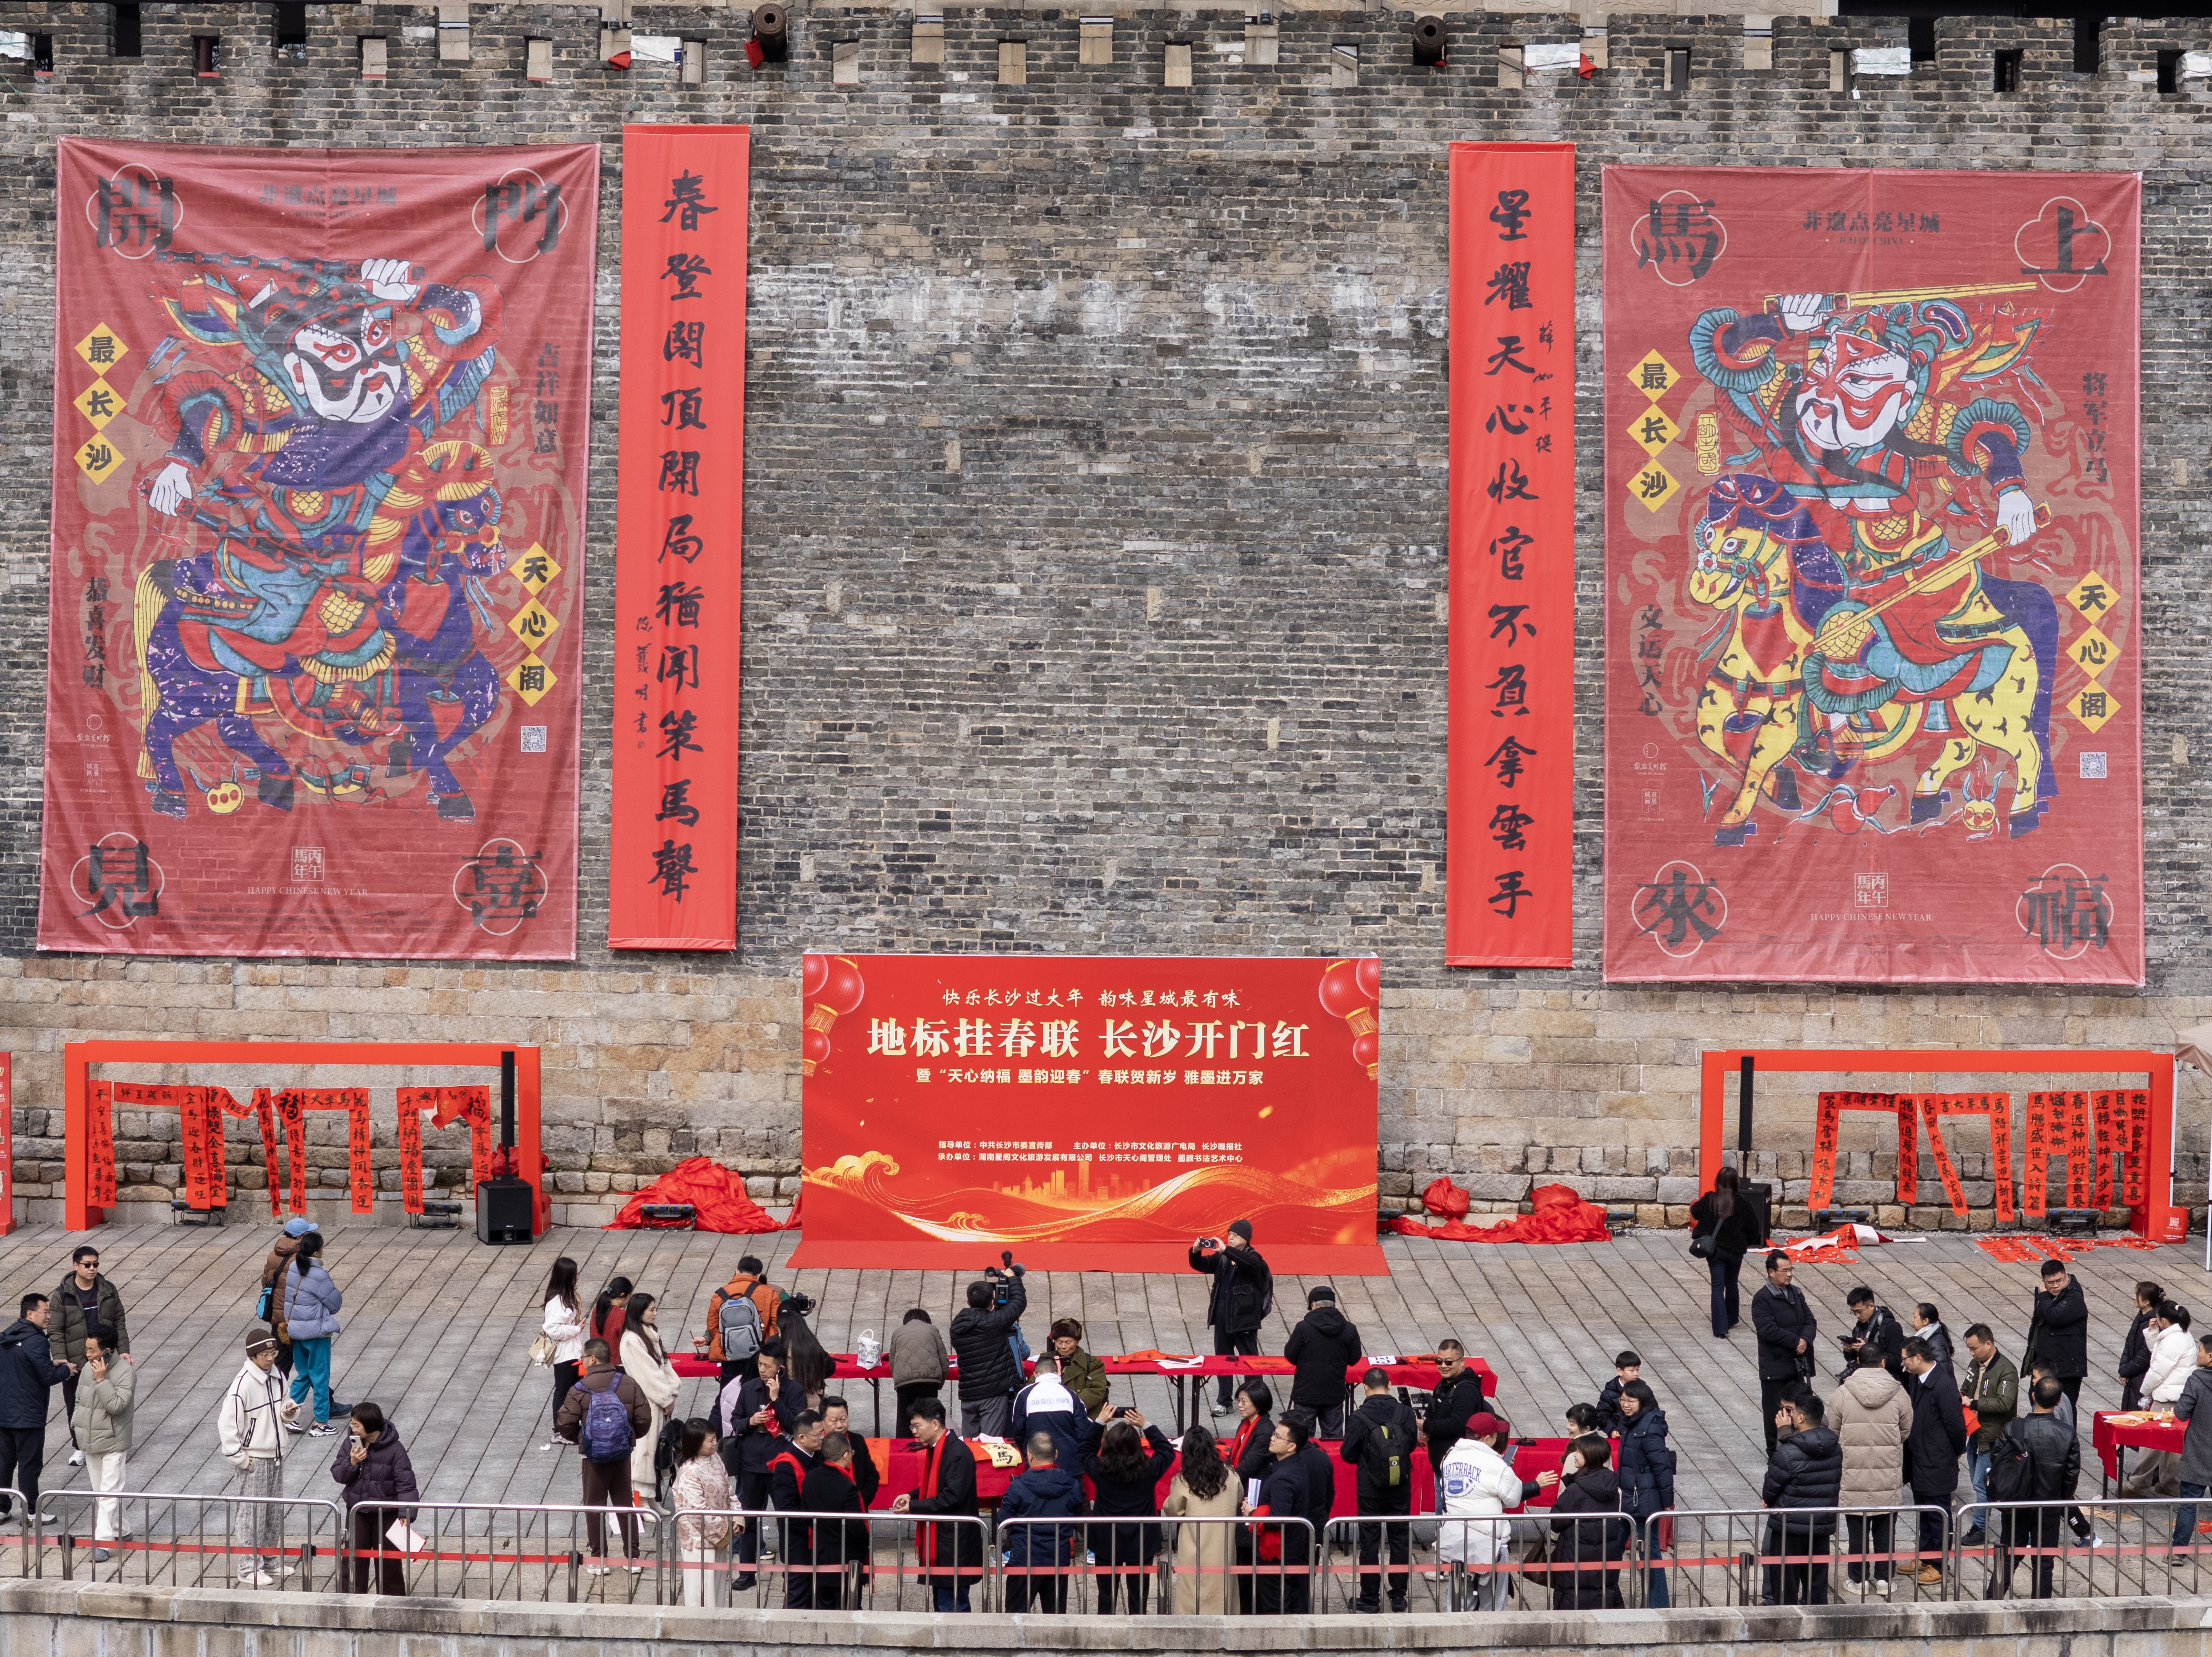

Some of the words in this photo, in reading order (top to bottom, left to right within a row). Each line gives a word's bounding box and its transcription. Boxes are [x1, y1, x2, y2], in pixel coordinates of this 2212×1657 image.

[95, 172, 174, 248] 開
[483, 182, 561, 254] 門
[1637, 198, 1720, 279] 馬
[2020, 205, 2108, 276] 上
[86, 336, 115, 471] 最长沙
[534, 343, 561, 453] 吉祥如意
[1640, 362, 1669, 499] 最长沙
[2082, 371, 2109, 484] 将军立马
[82, 576, 110, 691] 恭喜发财
[519, 556, 547, 693] 天心阁
[1637, 605, 1664, 717] 文运天心
[2078, 584, 2108, 720] 天心阁
[74, 840, 159, 920] 見
[460, 846, 544, 926] 喜
[1636, 870, 1722, 947] 來
[2022, 875, 2111, 952] 福
[942, 988, 1083, 1008] 快乐长沙过大年
[1098, 988, 1240, 1008] 韵味星城最有味
[867, 1020, 1079, 1058] 地标挂春联
[1099, 1020, 1309, 1059] 长沙开门红
[1098, 1068, 1175, 1085] 春联贺新岁
[1184, 1069, 1263, 1085] 雅墨进万家
